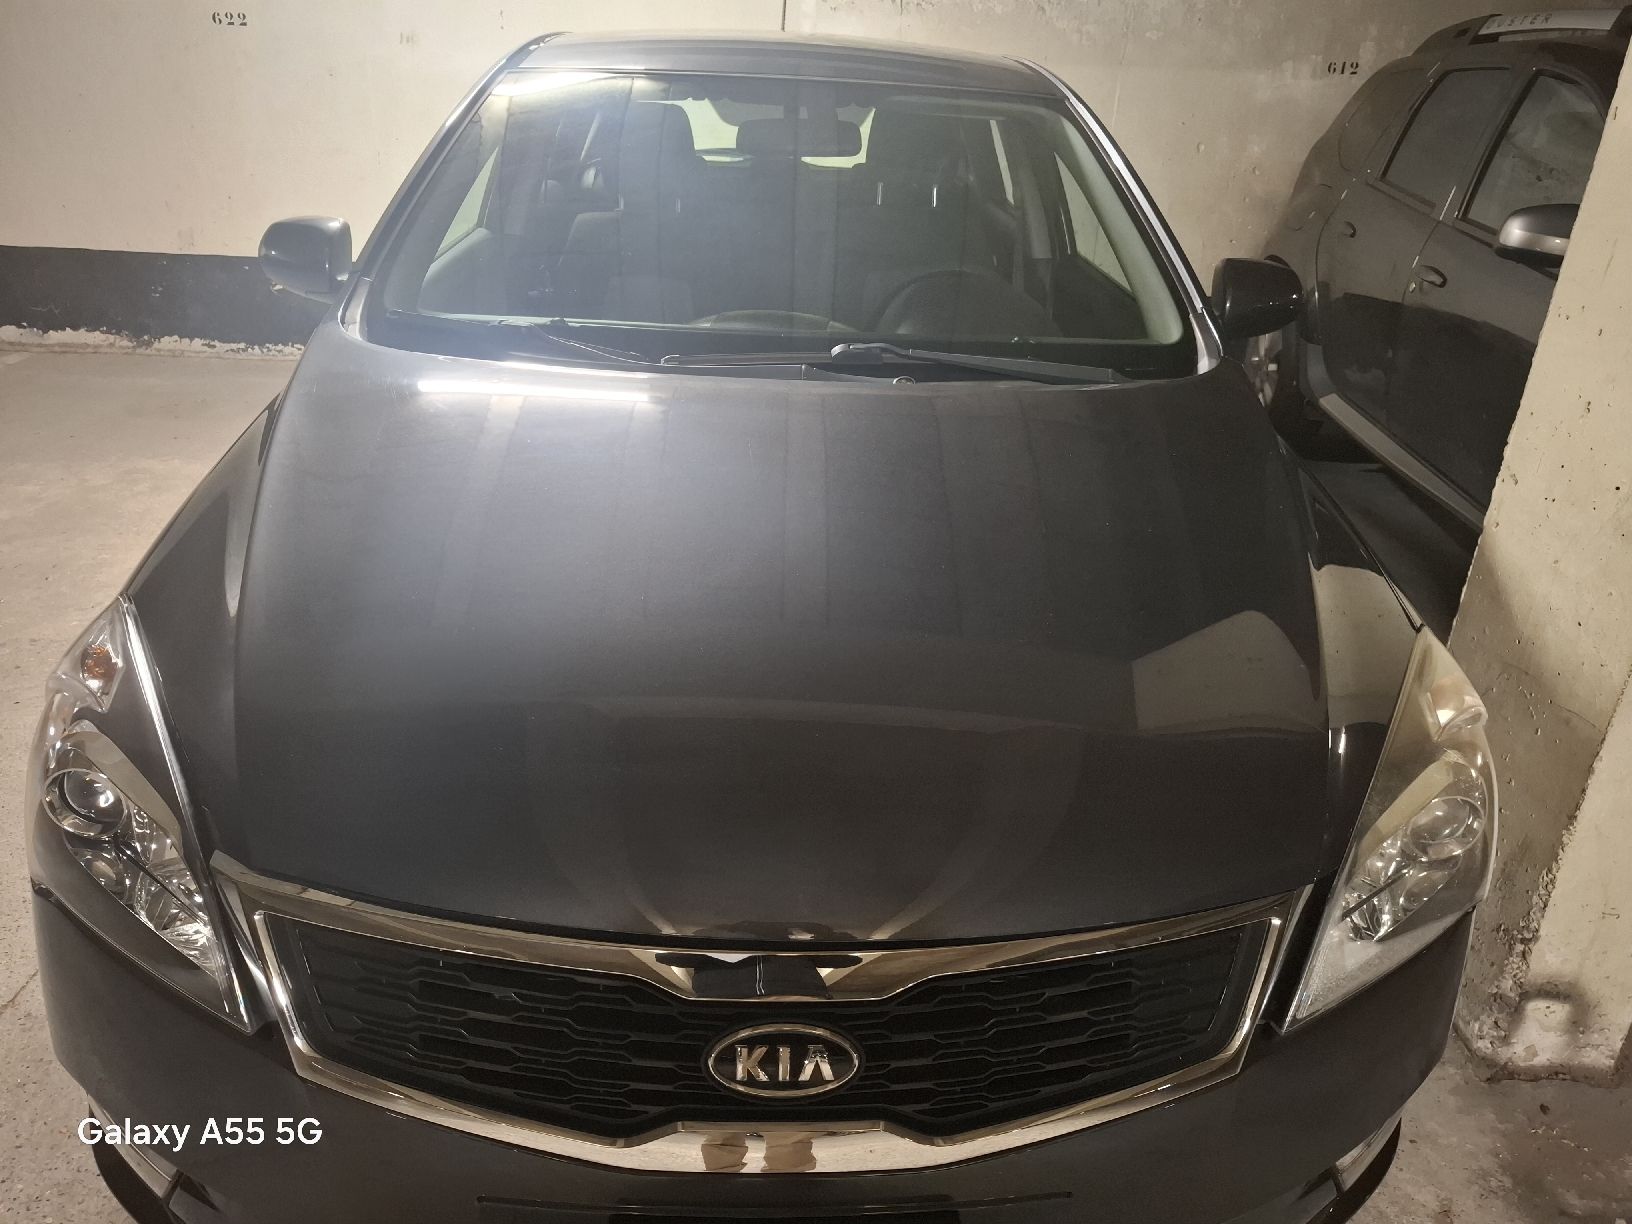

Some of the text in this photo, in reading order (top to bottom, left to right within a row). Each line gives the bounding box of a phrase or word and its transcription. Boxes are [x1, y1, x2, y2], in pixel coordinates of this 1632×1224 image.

[211, 11, 248, 27] 622
[1327, 61, 1359, 75] 612
[734, 1044, 835, 1082] KIA
